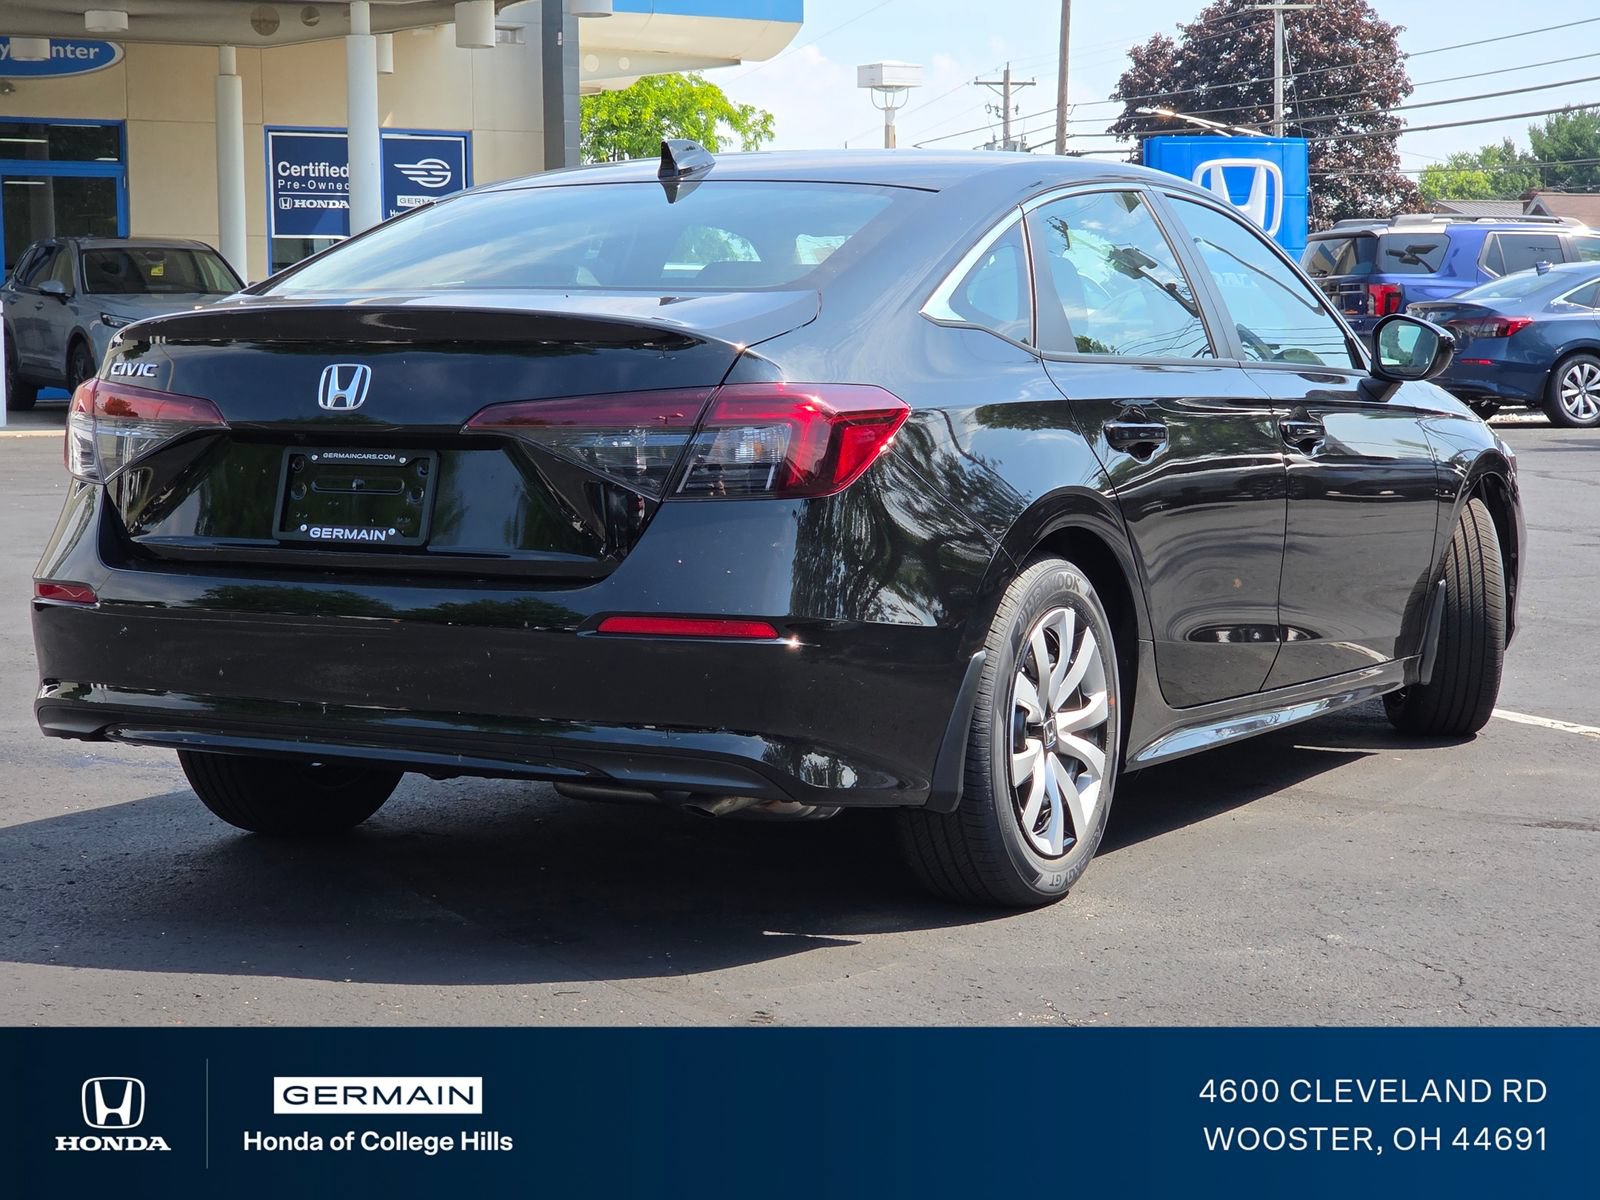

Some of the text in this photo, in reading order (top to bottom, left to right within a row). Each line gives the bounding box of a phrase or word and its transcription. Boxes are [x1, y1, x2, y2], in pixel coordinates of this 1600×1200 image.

[51, 43, 100, 59] nter
[277, 161, 349, 178] Certified
[293, 199, 350, 209] HONDA
[110, 362, 158, 377] CIVIC
[322, 452, 396, 461] GERMAINCARS.COM
[309, 526, 387, 542] GERMAIN
